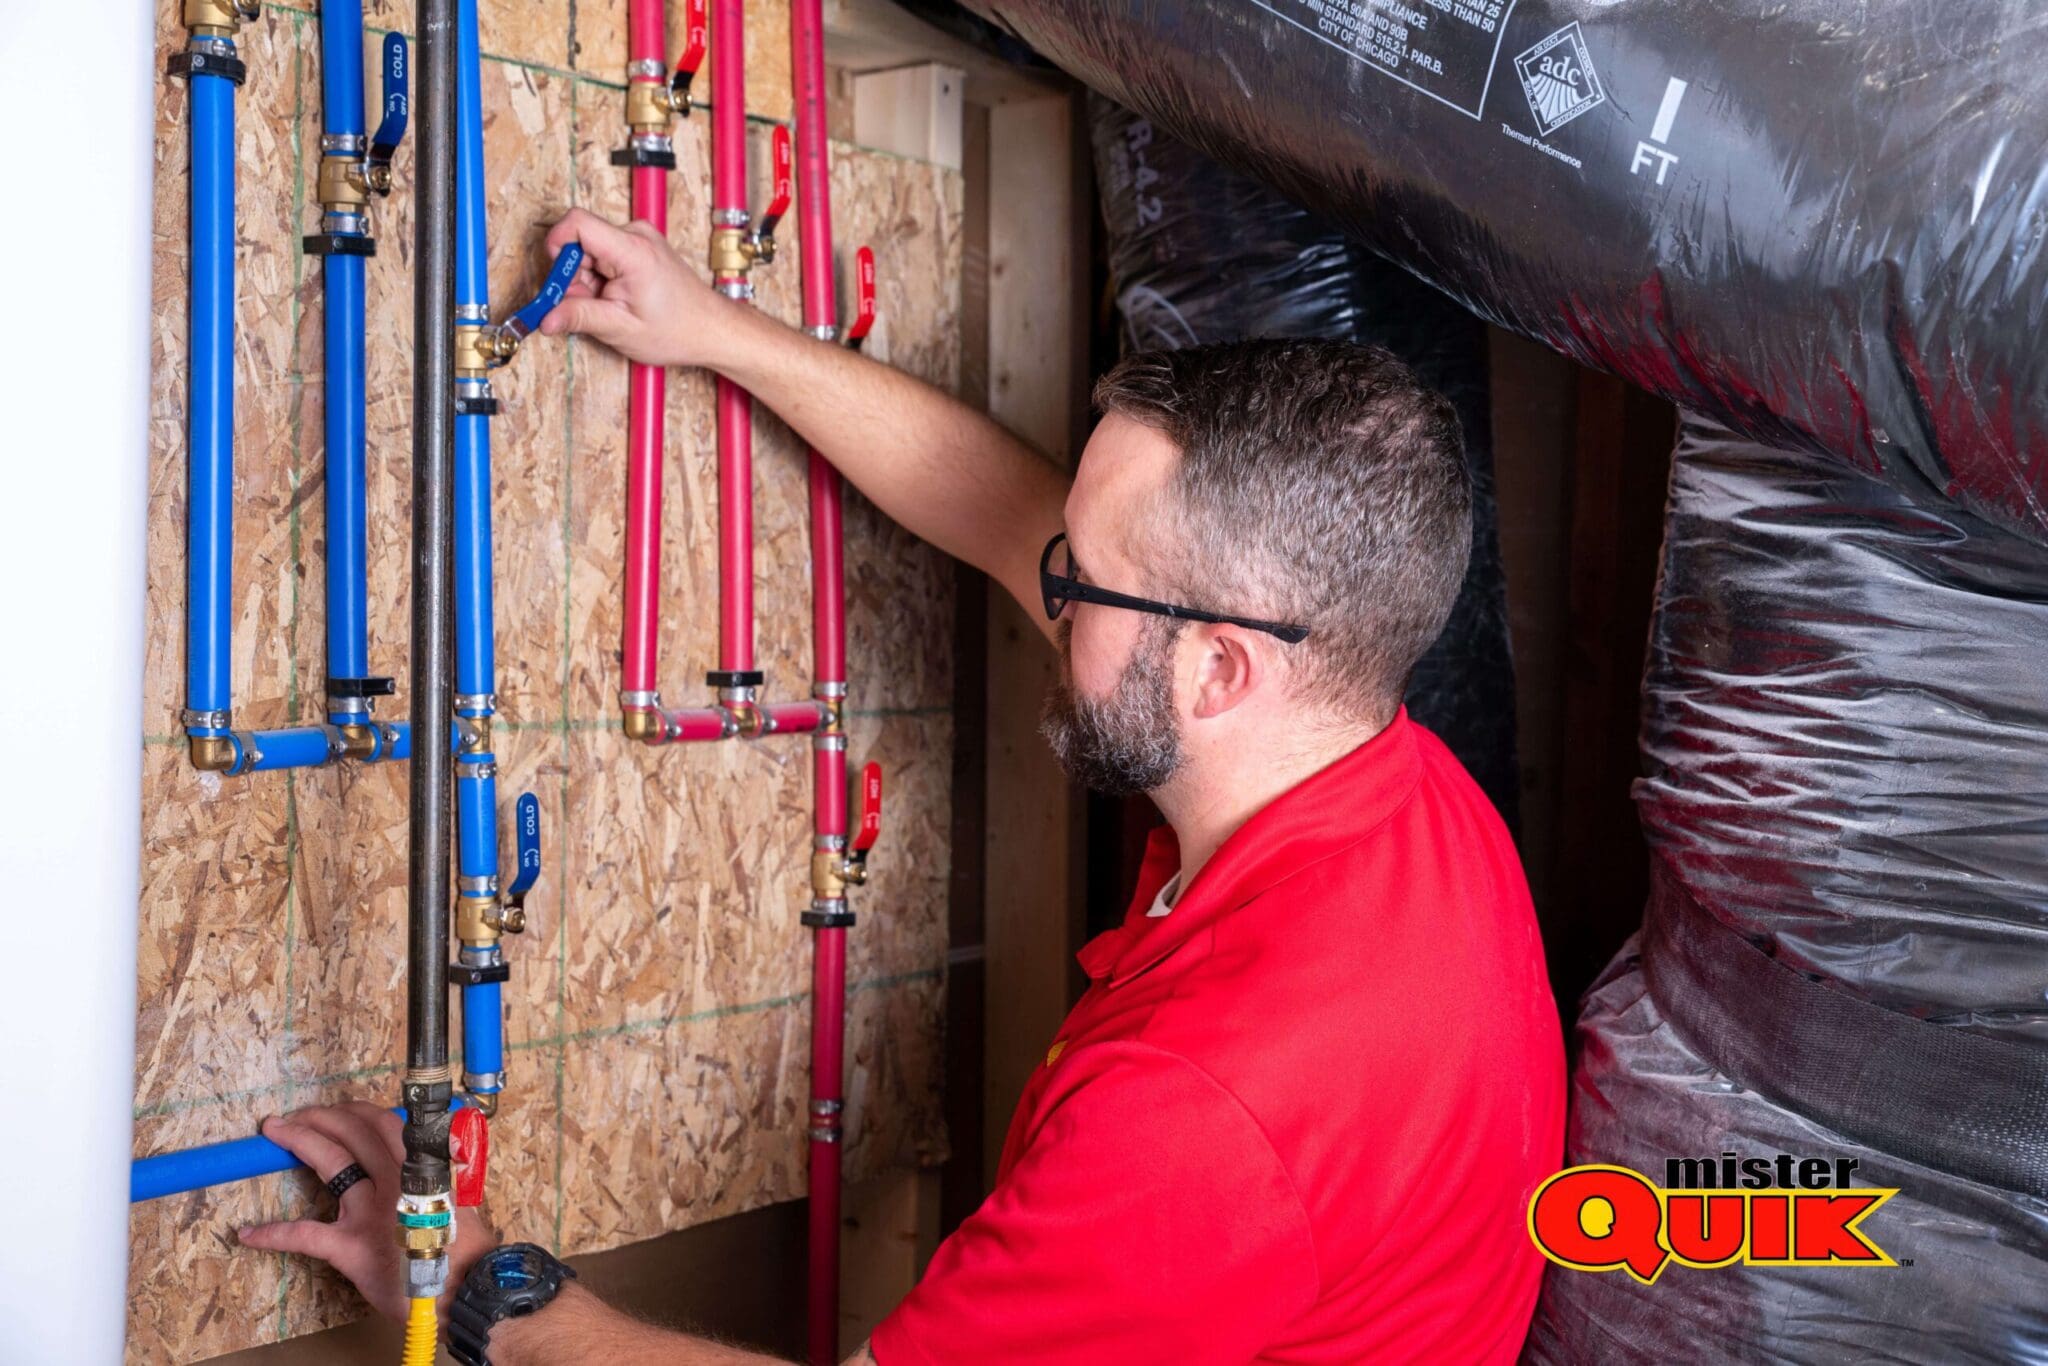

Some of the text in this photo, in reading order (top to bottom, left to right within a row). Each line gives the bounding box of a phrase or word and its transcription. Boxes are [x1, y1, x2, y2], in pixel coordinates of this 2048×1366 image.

[1350, 3, 1367, 20] 90A
[1368, 12, 1389, 31] AND
[1391, 23, 1408, 41] 90B
[1369, 0, 1428, 30] MPLIANCE
[1453, 3, 1481, 27] THAN
[1481, 17, 1495, 33] 50
[1486, 4, 1501, 19] 25
[1319, 17, 1399, 67] CITY OF CHICAGO
[1325, 5, 1375, 39] STANDARD
[1411, 49, 1444, 76] PAR.B.
[393, 44, 403, 78] COLD
[1539, 56, 1581, 86] adc
[1502, 123, 1582, 168] Thermal Performance
[1630, 140, 1679, 186] FT
[562, 249, 579, 277] COLD
[526, 804, 535, 835] COLD
